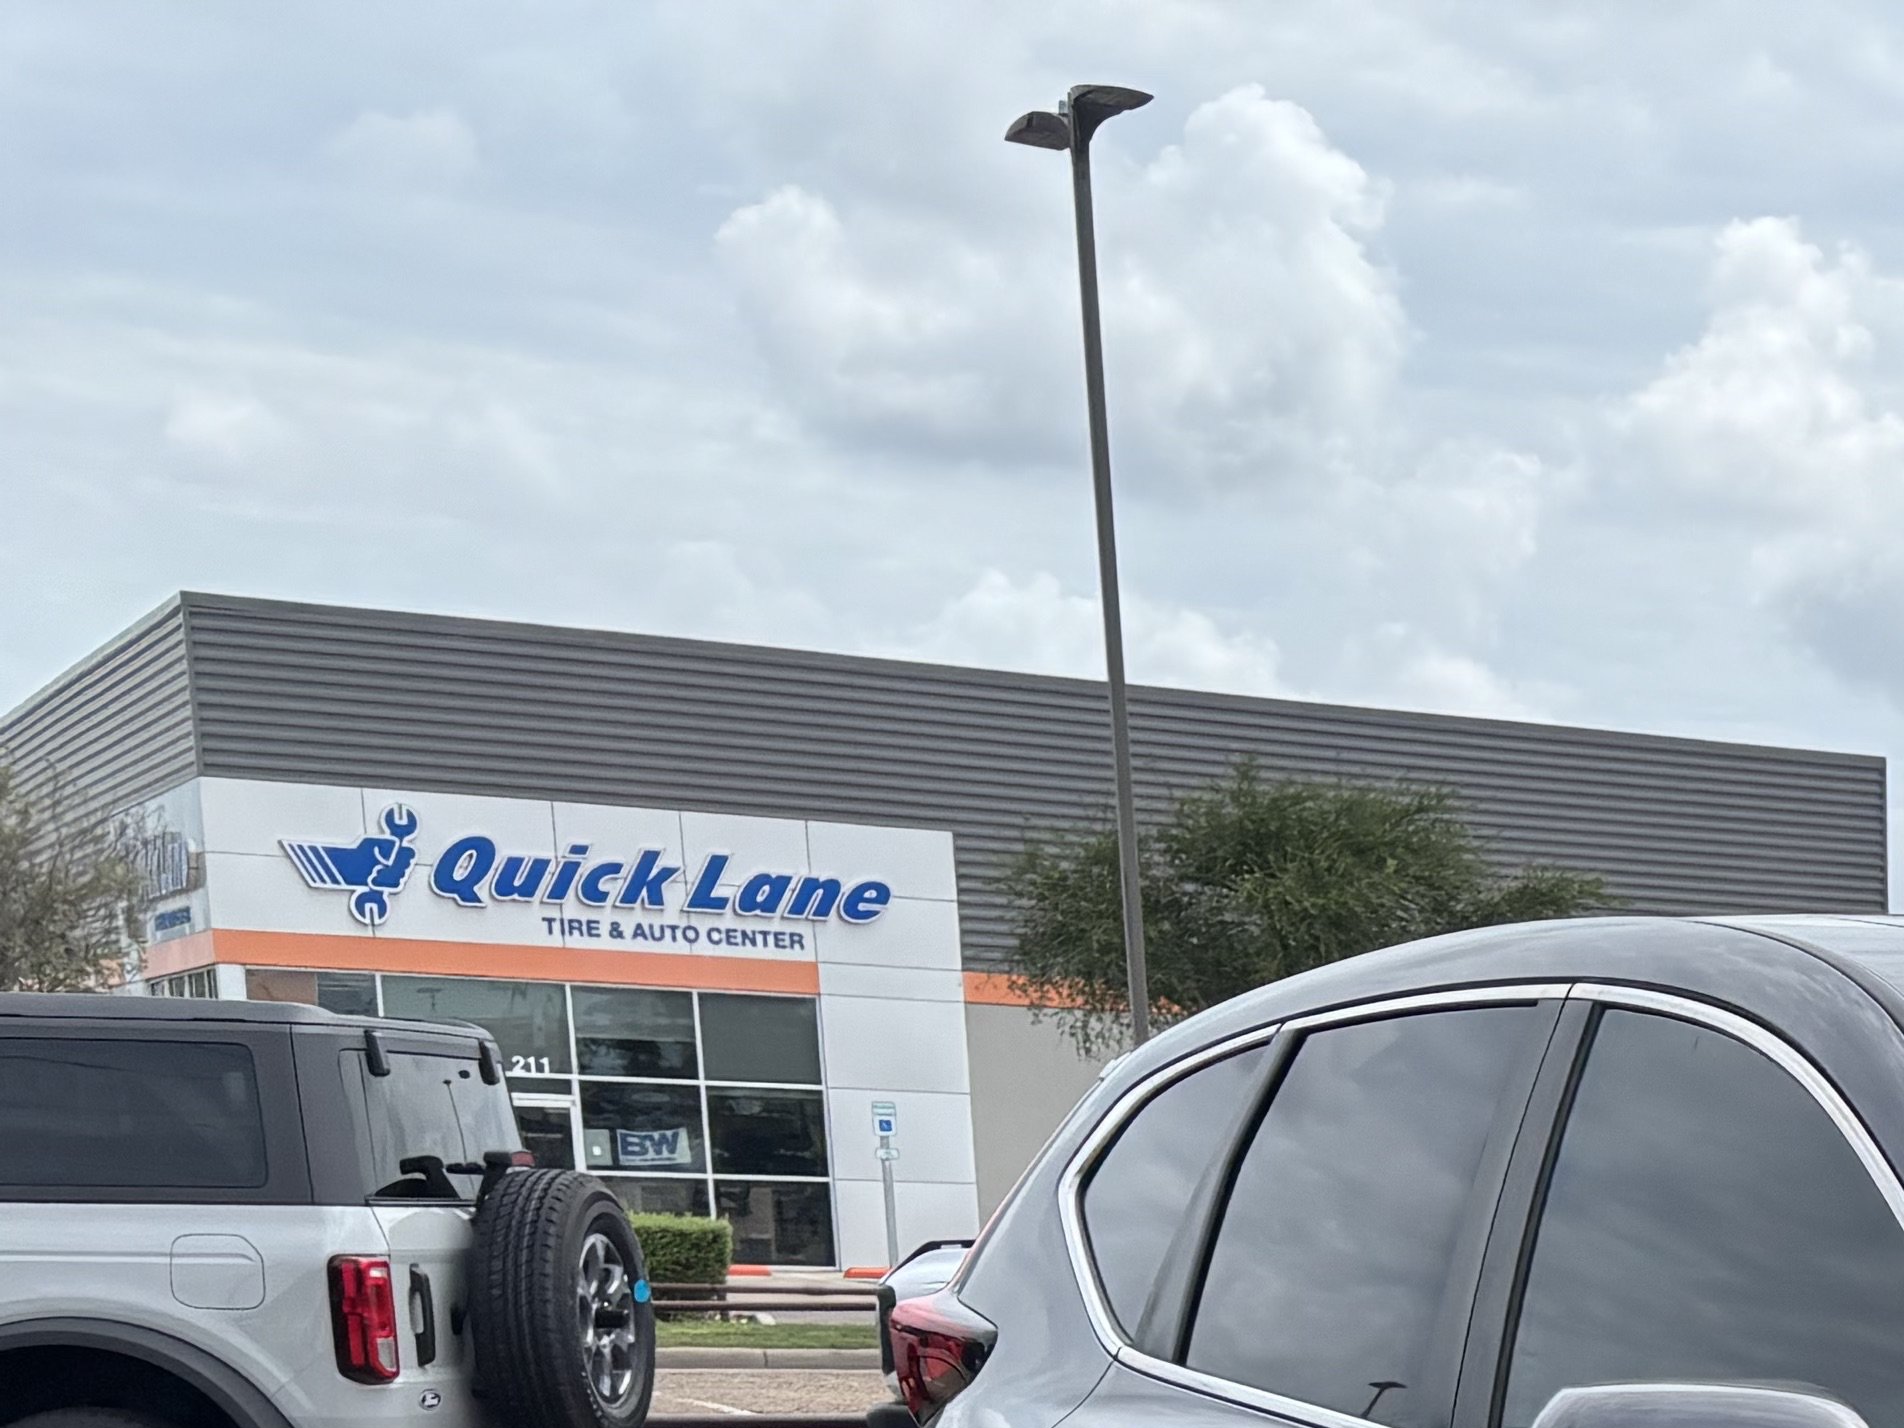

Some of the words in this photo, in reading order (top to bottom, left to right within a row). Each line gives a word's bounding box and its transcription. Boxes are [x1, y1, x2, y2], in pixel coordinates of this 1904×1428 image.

[431, 835, 681, 908] Quick
[683, 852, 892, 922] Lane
[542, 917, 601, 938] TIRE
[608, 921, 625, 940] &
[631, 922, 699, 945] AUTO
[706, 927, 806, 951] CENTER
[511, 1055, 550, 1074] 211
